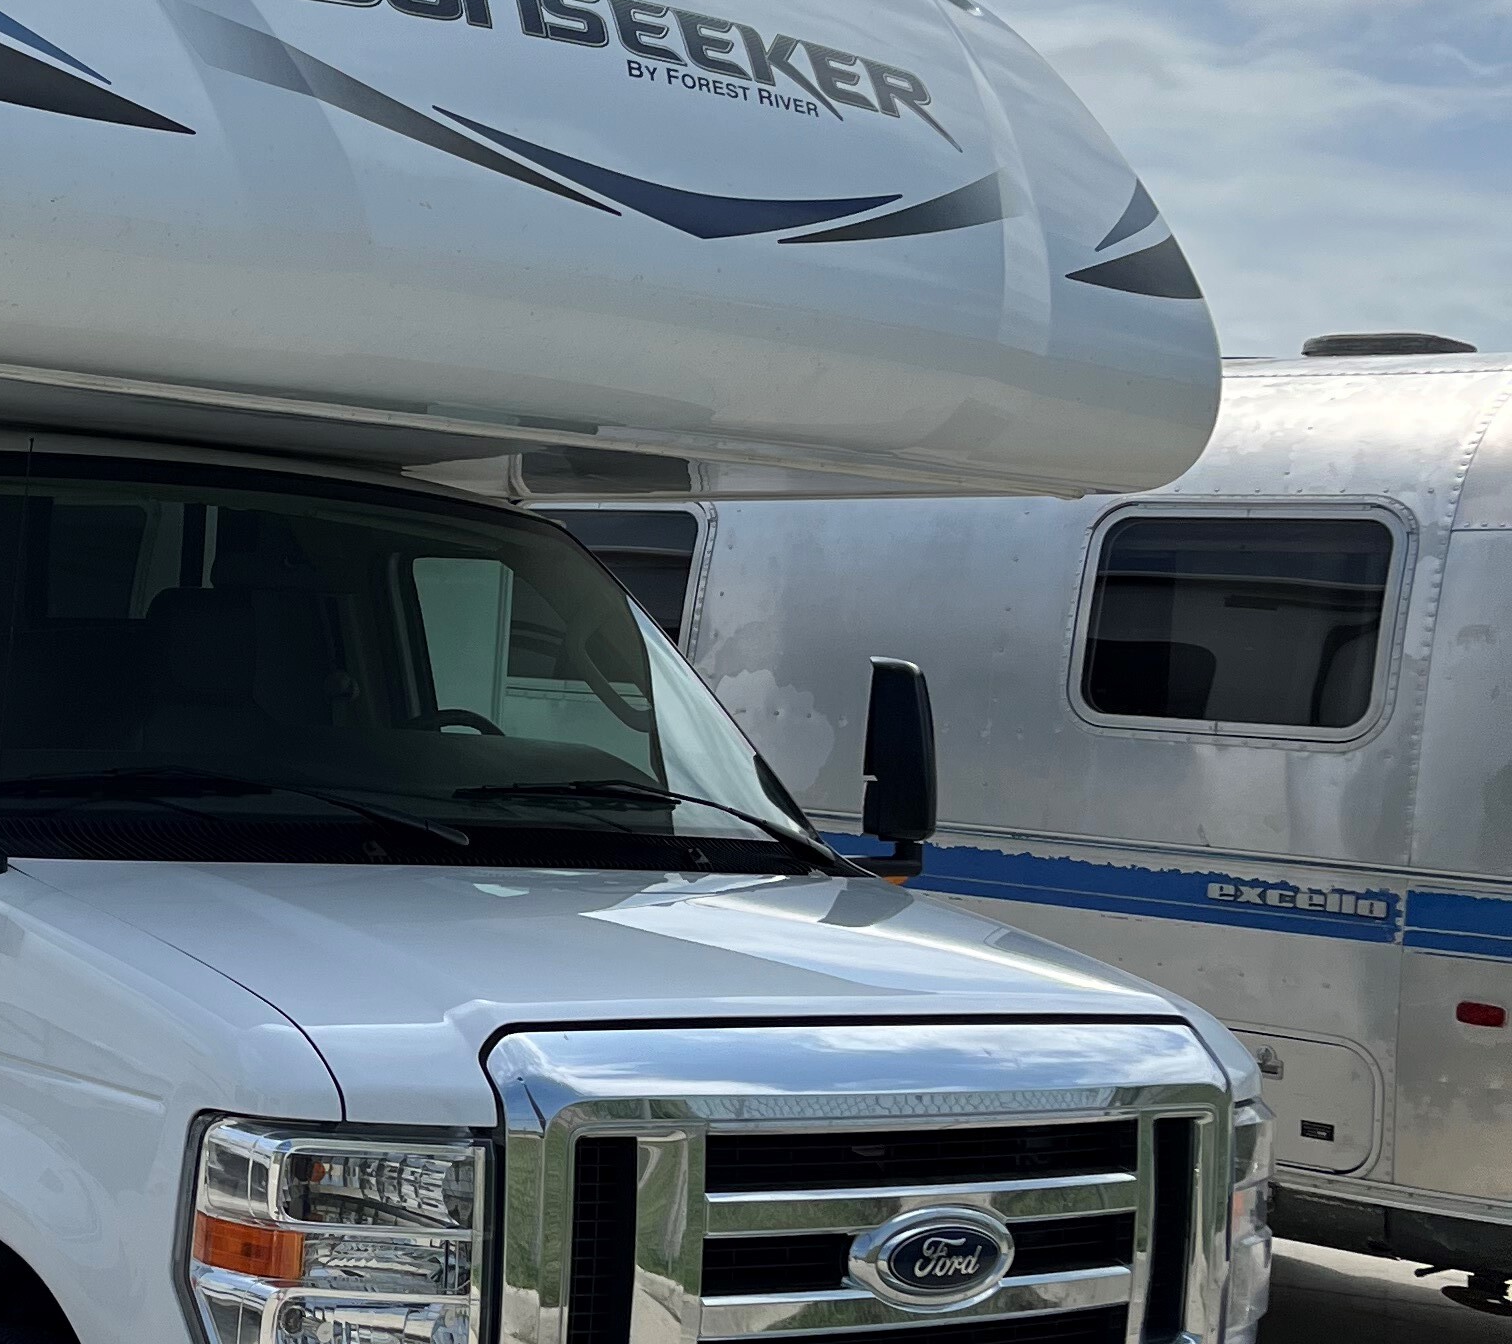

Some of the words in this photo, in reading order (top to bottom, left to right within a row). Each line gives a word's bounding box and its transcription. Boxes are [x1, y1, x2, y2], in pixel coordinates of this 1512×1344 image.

[666, 67, 750, 101] FOREST
[757, 87, 820, 118] RIVER
[1207, 882, 1388, 919] excello
[914, 1237, 982, 1278] Ford
